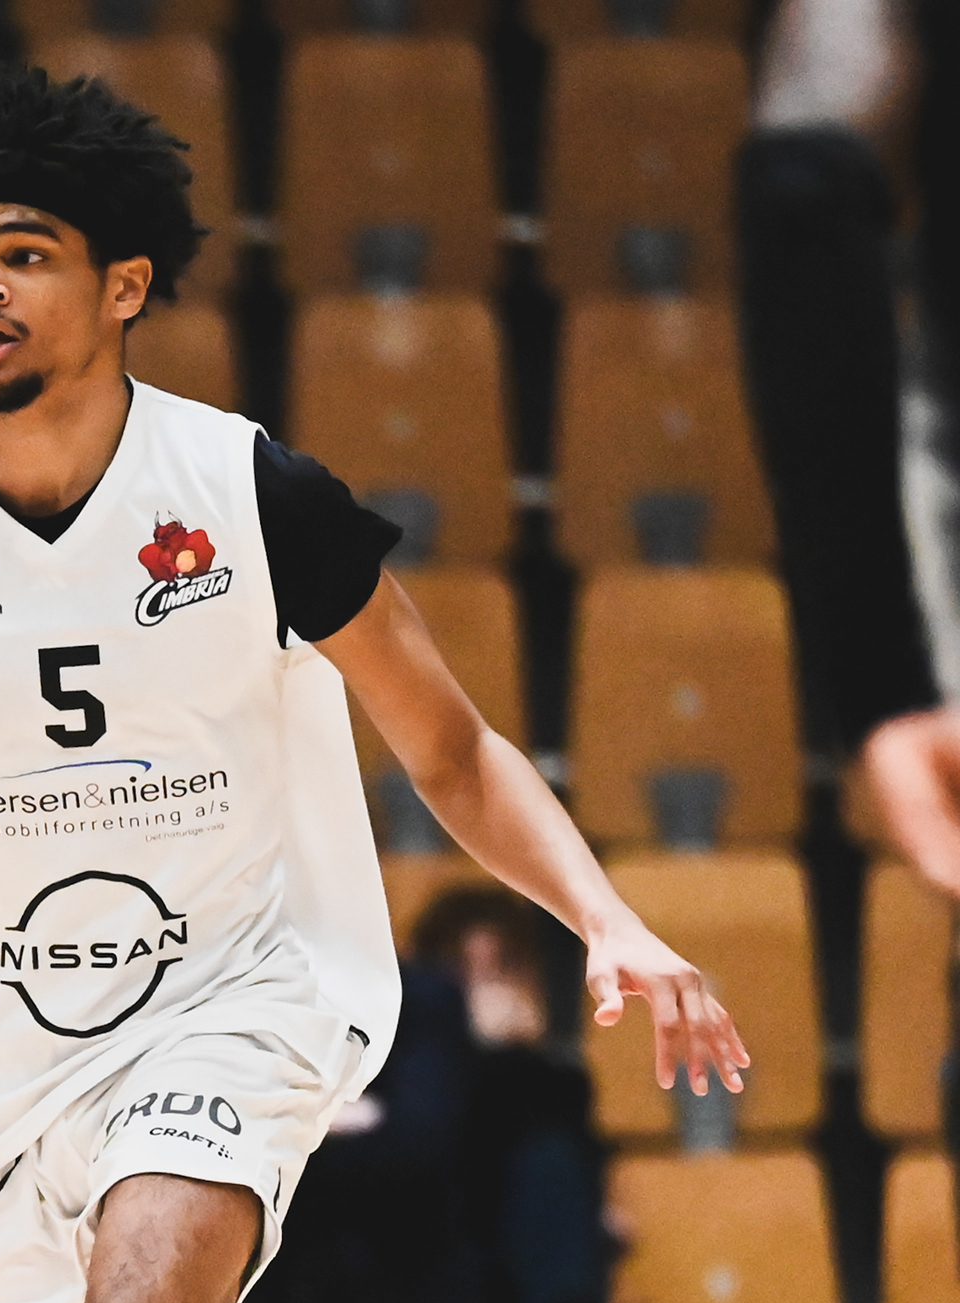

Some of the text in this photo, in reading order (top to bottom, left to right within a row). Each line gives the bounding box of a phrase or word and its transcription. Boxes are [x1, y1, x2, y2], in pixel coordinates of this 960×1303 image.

[38, 644, 107, 749] 5
[195, 800, 230, 818] a/s
[0, 920, 188, 970] NISSAN
[149, 1127, 218, 1149] CRAFT
